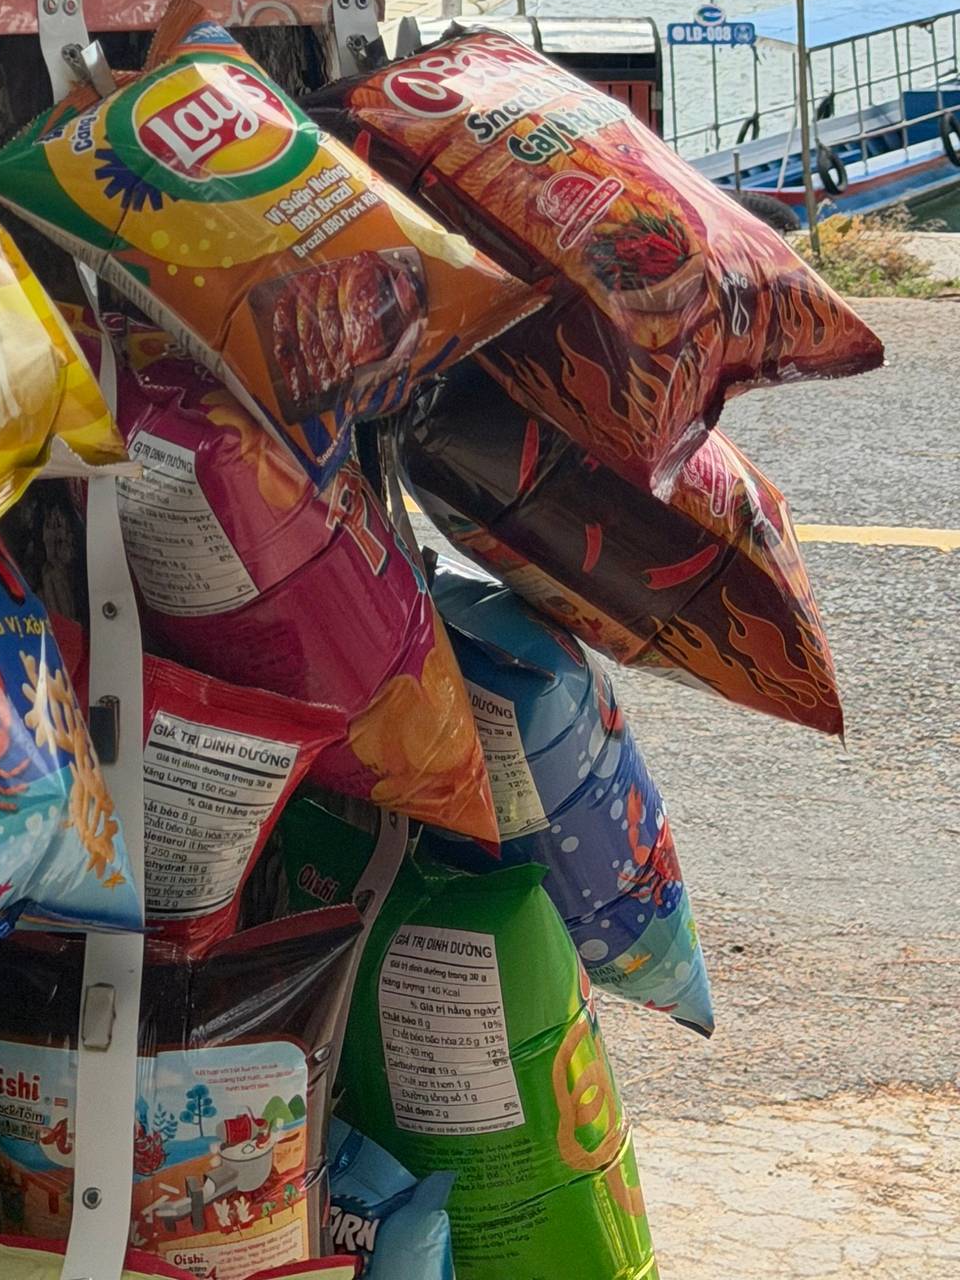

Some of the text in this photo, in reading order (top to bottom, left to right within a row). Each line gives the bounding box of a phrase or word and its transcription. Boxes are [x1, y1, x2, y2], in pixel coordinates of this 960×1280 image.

[290, 203, 322, 232] BBQ
[153, 723, 176, 738] GIÁ
[180, 729, 199, 748] TRỊ
[202, 737, 236, 756] DINH
